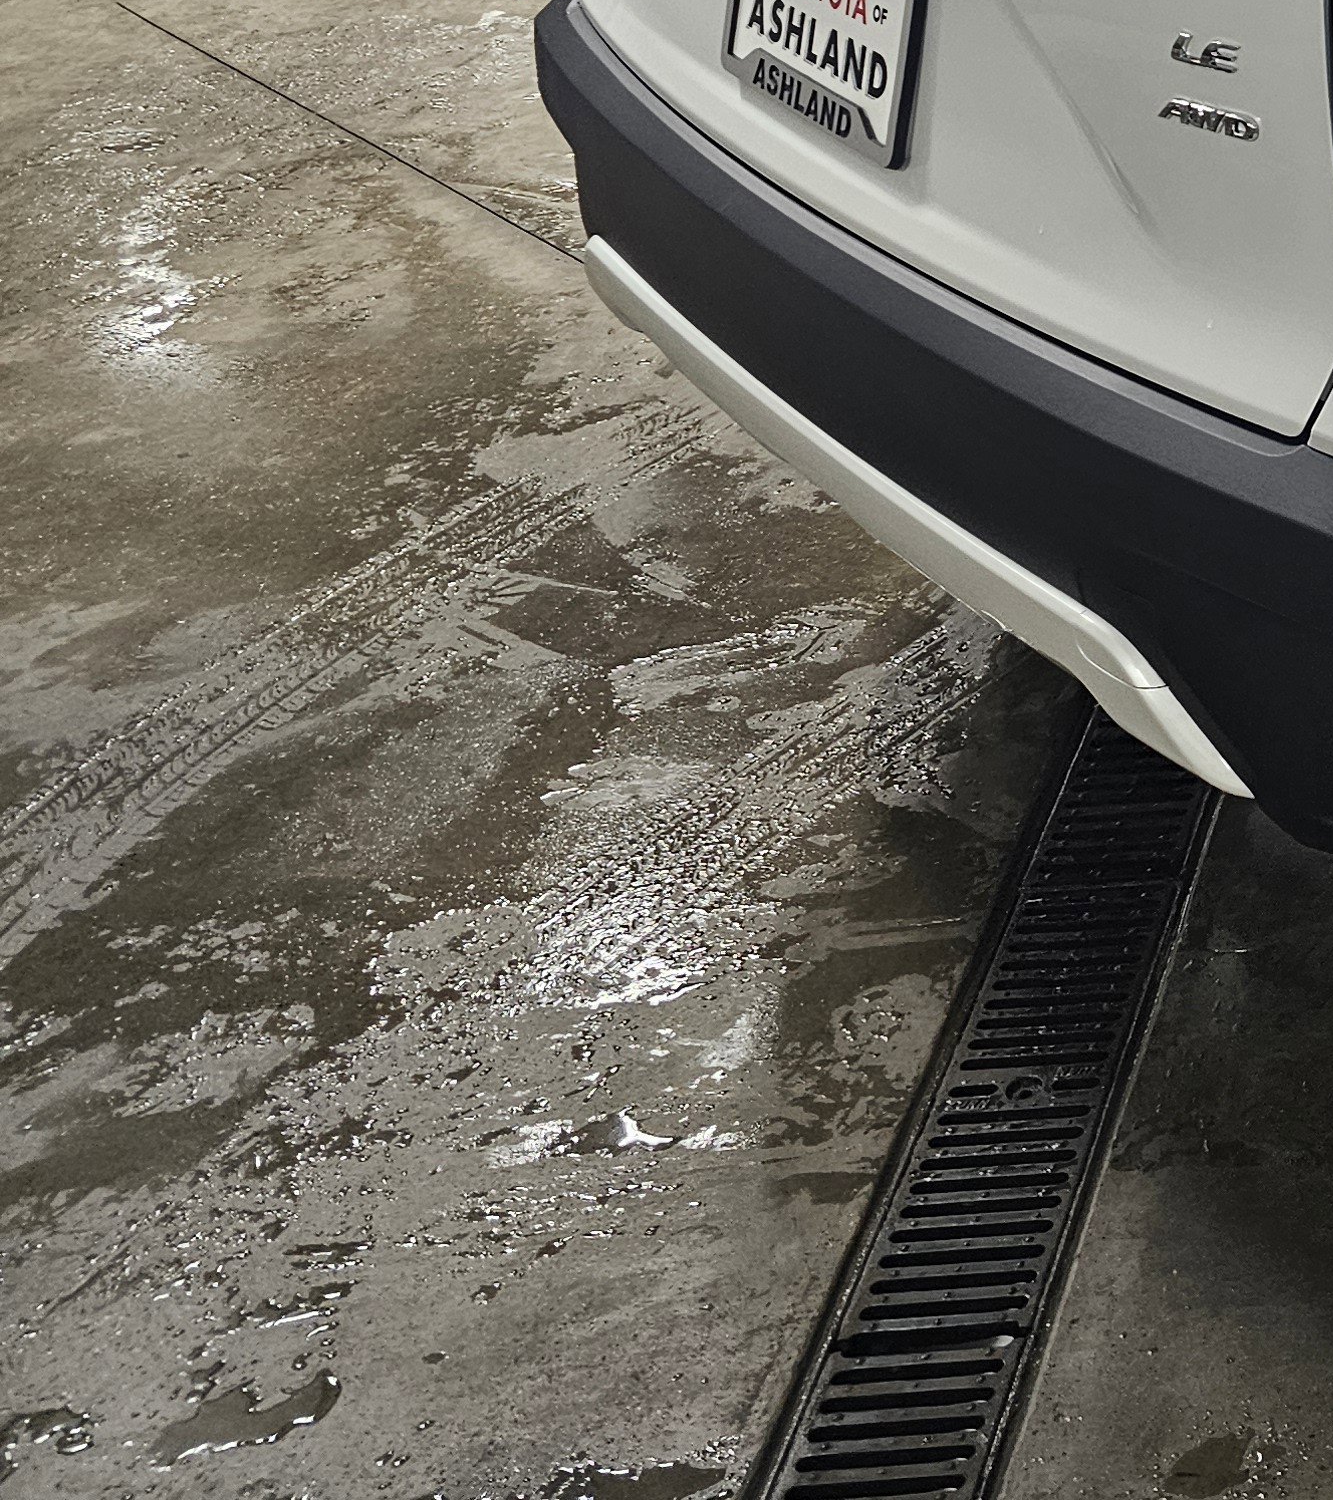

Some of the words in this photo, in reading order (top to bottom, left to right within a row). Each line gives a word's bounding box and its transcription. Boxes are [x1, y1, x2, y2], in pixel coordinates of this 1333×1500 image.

[872, 3, 889, 26] OF
[1170, 29, 1242, 74] LE
[752, 57, 852, 139] ASHLAND
[1157, 97, 1261, 143] AWD
